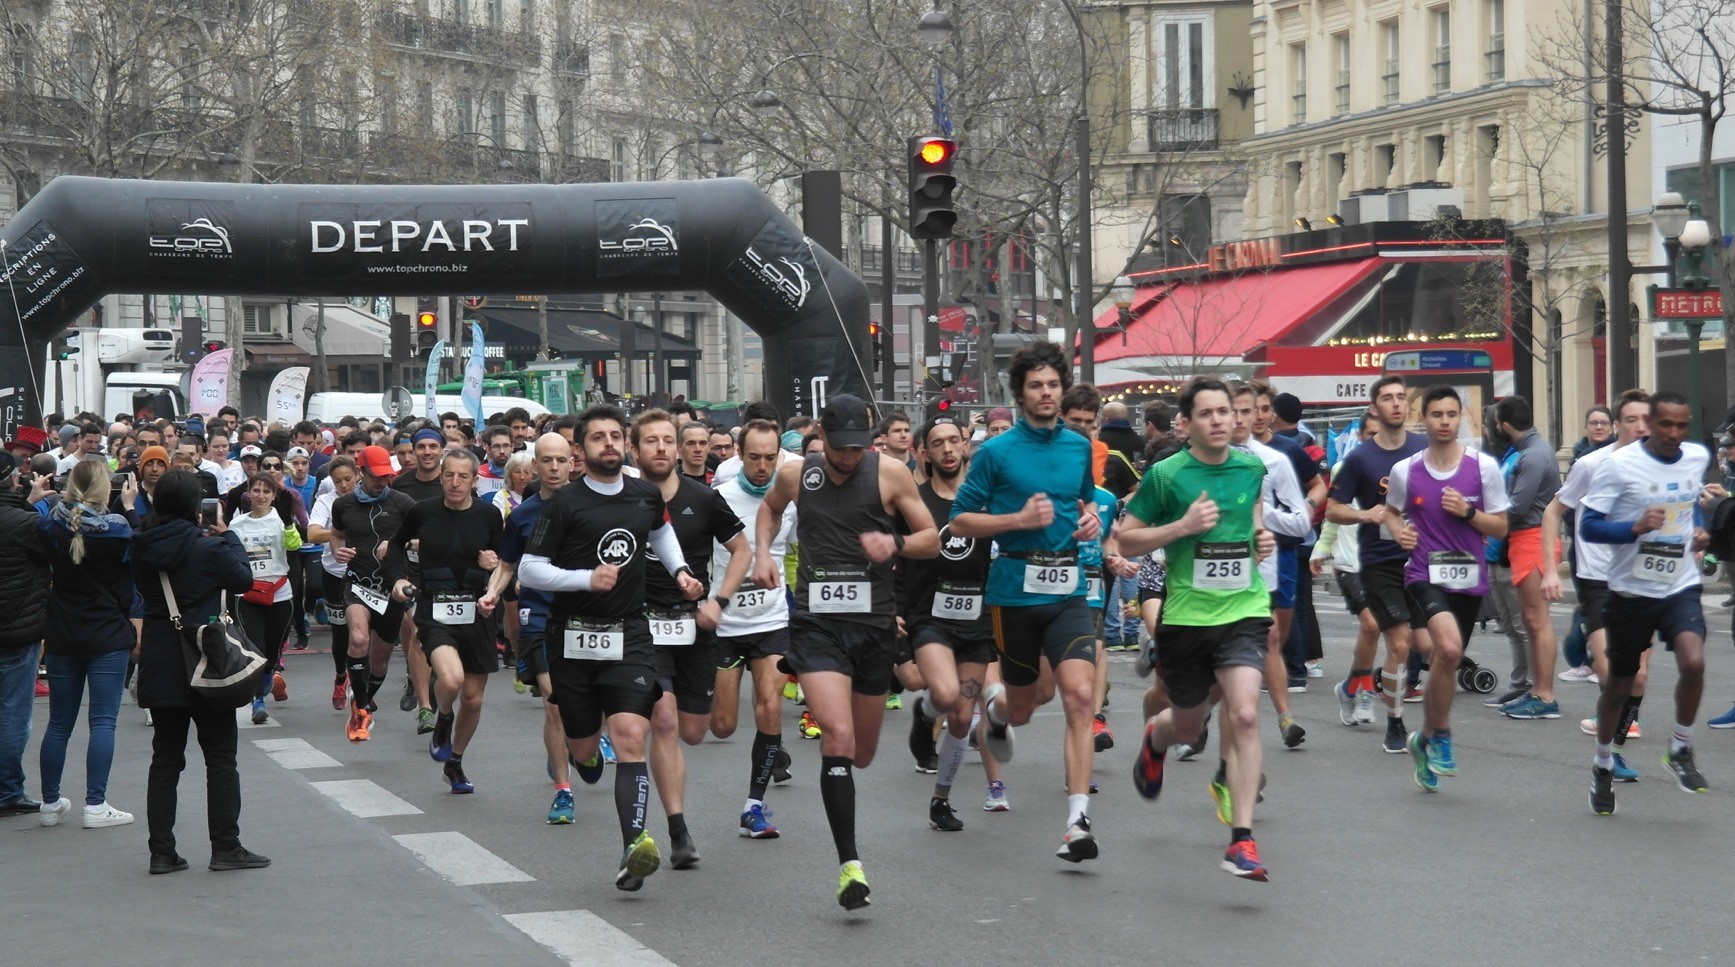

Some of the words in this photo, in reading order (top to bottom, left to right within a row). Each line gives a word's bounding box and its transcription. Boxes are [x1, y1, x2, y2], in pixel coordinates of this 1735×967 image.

[310, 218, 529, 253] DEPART
[27, 262, 42, 276] EN
[367, 263, 468, 273] www.topchrono.biz
[26, 267, 58, 294] LIGNE
[21, 266, 85, 320] www.topchrono.biz
[1354, 352, 1369, 368] LE
[1336, 384, 1367, 398] CAFE
[1206, 561, 1241, 577] 258
[1644, 556, 1676, 573] 660
[1036, 569, 1069, 583] 405
[1440, 567, 1468, 579] 609
[358, 589, 379, 606] 404
[737, 591, 766, 608] 237
[821, 585, 857, 601] 645
[446, 604, 464, 616] 35
[944, 597, 973, 611] 588
[652, 622, 684, 635] 195
[576, 633, 611, 649] 186
